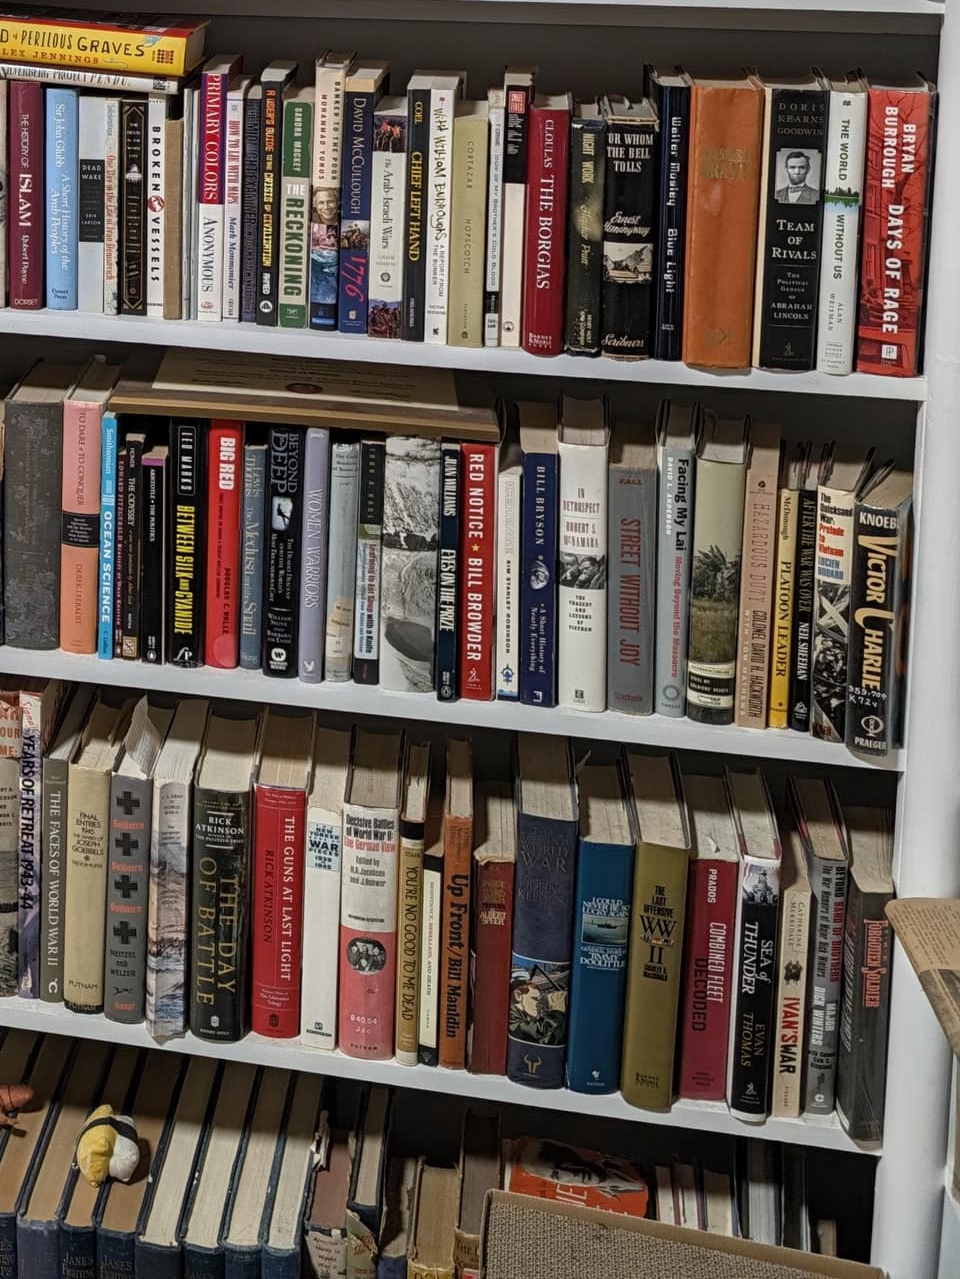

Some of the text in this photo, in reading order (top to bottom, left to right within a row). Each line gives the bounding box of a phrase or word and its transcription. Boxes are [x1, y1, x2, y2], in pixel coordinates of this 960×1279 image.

[21, 30, 73, 50] PERILOUS
[77, 36, 145, 57] GRAVES
[33, 52, 99, 65] JENNINGS
[151, 126, 162, 191] BROKEN
[202, 74, 222, 202] PRIMARY COLORS
[350, 98, 366, 215] DAVID McCULLOUGH
[882, 106, 899, 190] BURROUGH
[902, 124, 917, 174] BRYAN
[18, 174, 32, 227] ISLAM
[286, 184, 305, 195] THE
[776, 219, 815, 232] TEAM
[150, 217, 160, 281] VESSELS
[201, 217, 216, 292] ANONYMOUS
[284, 198, 304, 297] RECKONING
[535, 174, 554, 290] THE BORGIAS
[771, 247, 817, 260] RIVALS
[788, 236, 803, 246] OF
[341, 257, 366, 303] 1776
[882, 204, 904, 334] DAYS OF RAGE
[219, 437, 236, 490] BIG RED
[469, 453, 484, 539] RED NOTICE
[467, 558, 482, 661] BILL BROWDER
[619, 517, 642, 666] STREET WITHOUT JOY
[853, 533, 898, 690] VICTOR CHARLIE
[855, 736, 887, 750] PRAEGER
[309, 841, 338, 852] WAR
[197, 856, 217, 1006] OF BATTLE
[217, 874, 237, 994] THE DAY
[742, 921, 758, 994] THUNDER
[692, 958, 708, 1031] DECODED
[779, 997, 800, 1075] IVAN'S WAR
